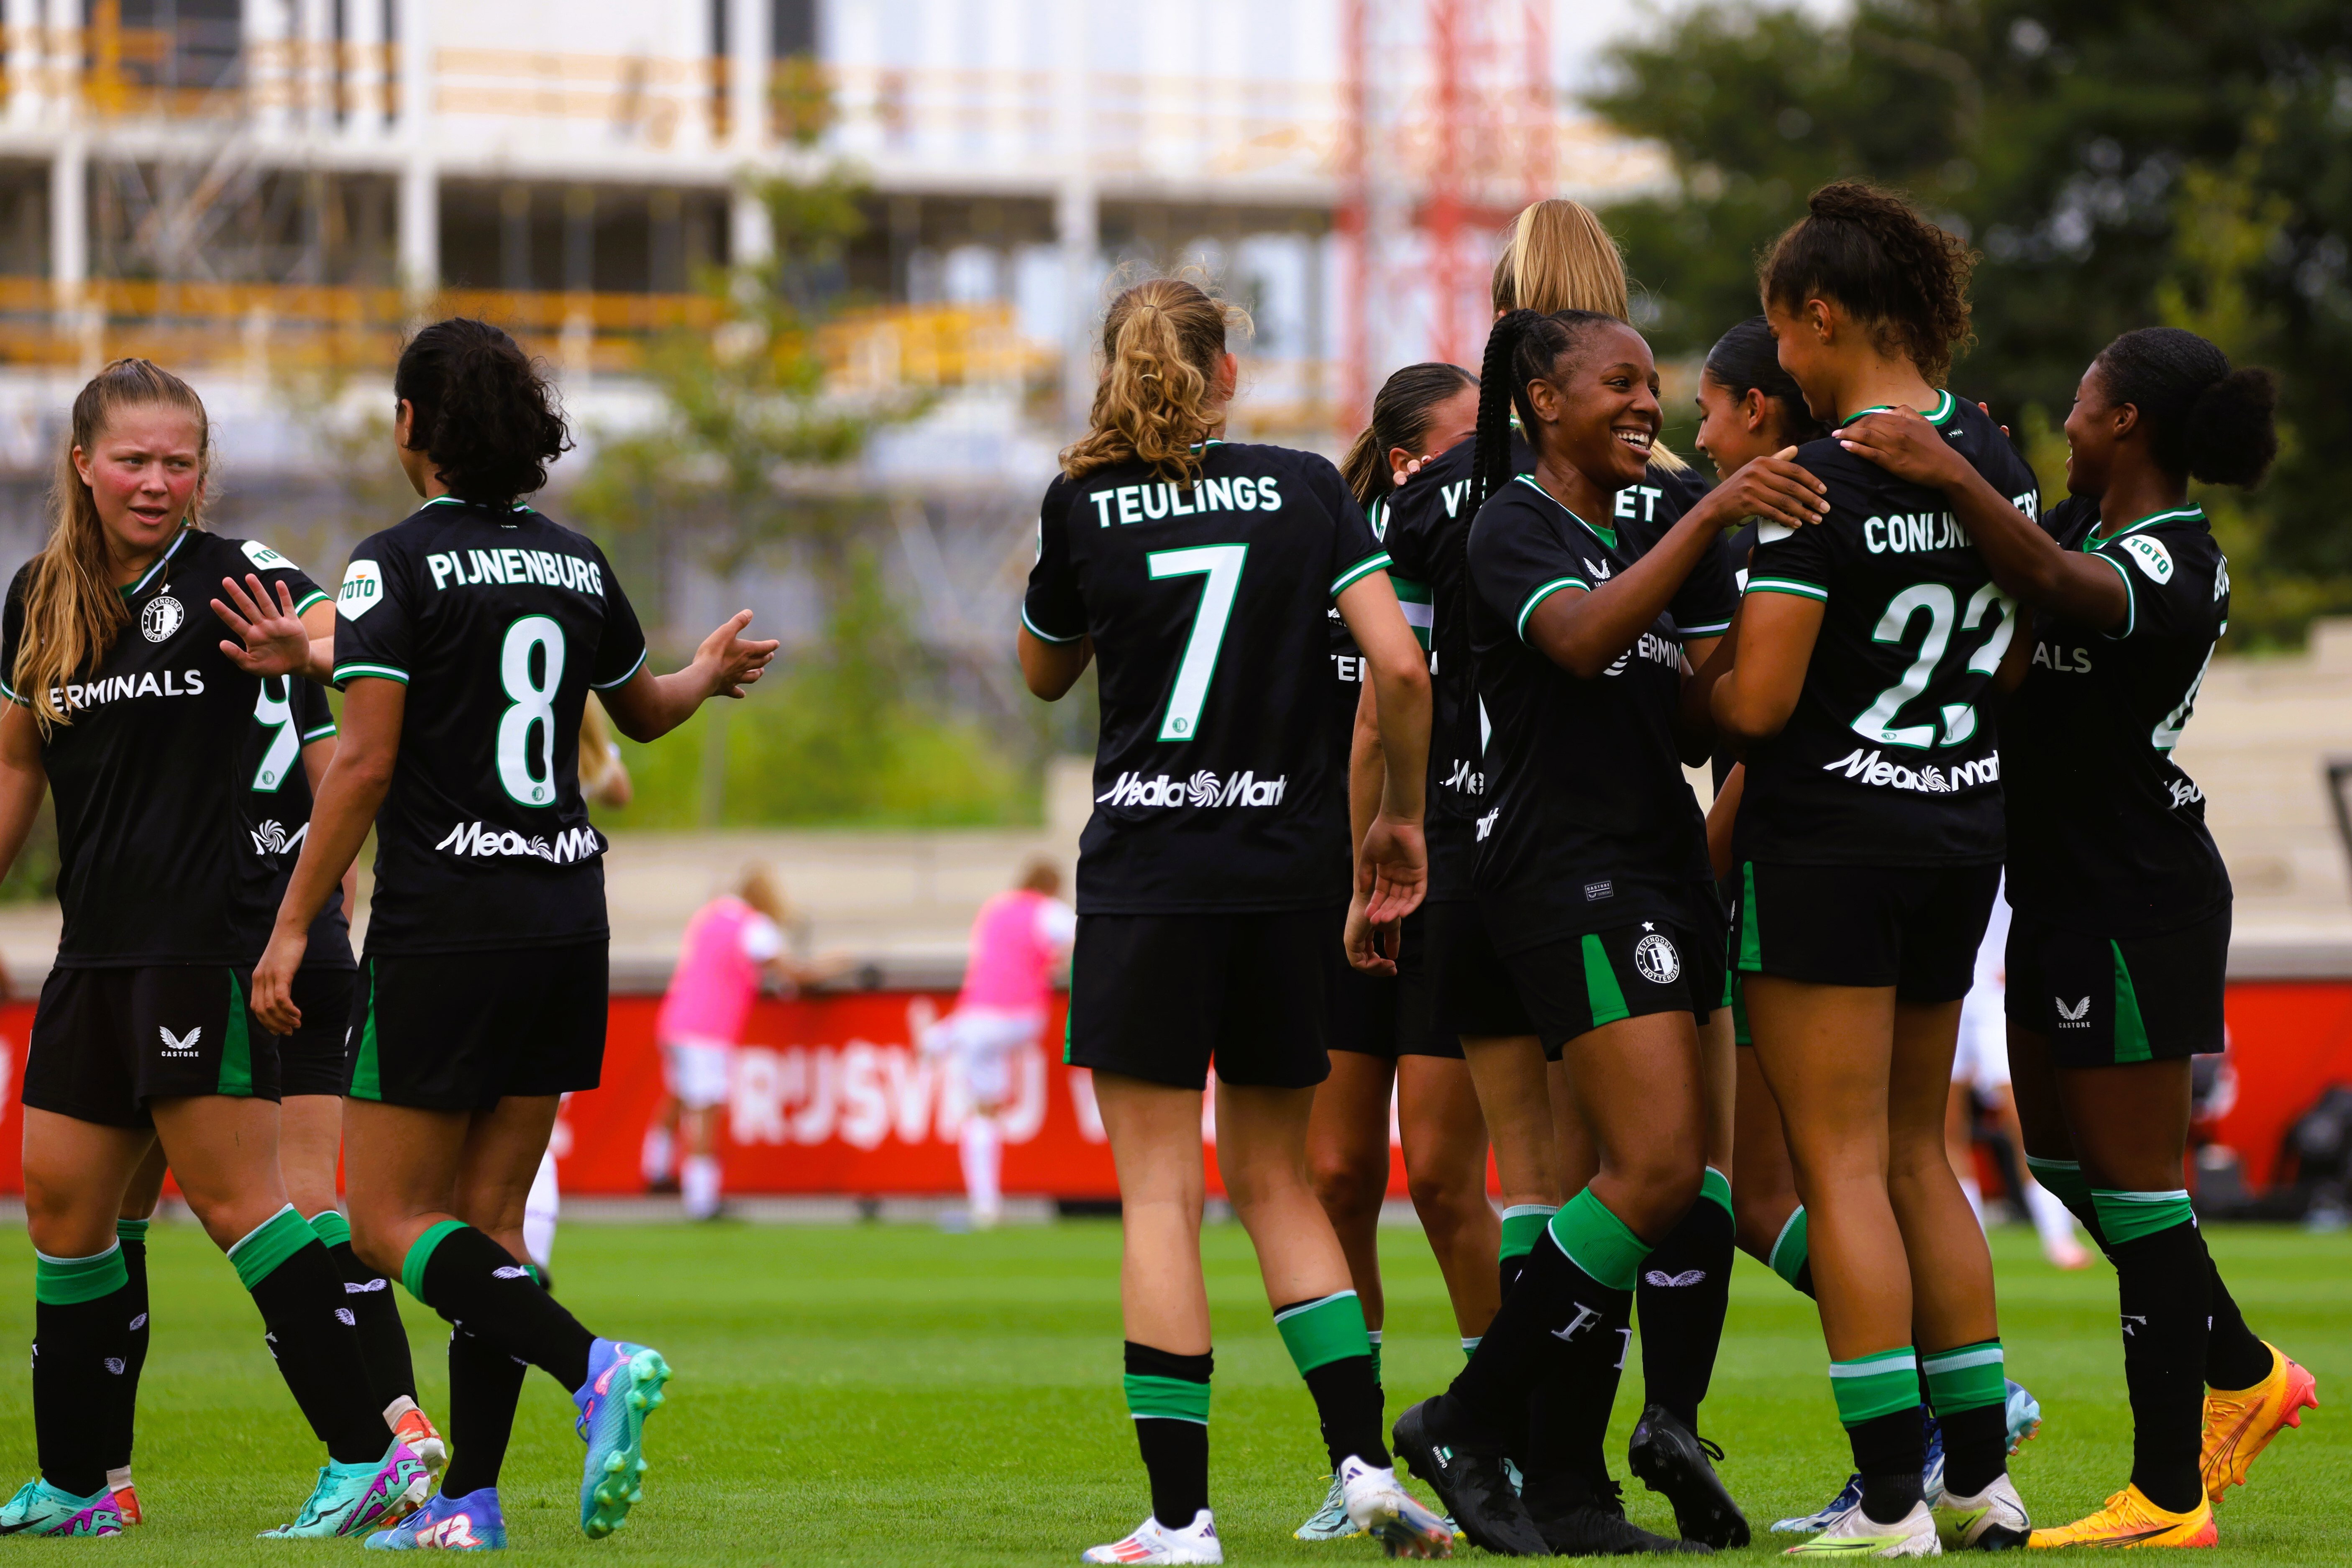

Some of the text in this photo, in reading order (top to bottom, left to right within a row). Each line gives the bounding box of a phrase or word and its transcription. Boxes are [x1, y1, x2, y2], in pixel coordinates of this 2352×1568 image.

[1090, 476, 1282, 528] TEULINGS
[2131, 538, 2169, 575] TOTO
[426, 548, 604, 597] PIJNENBURG
[341, 579, 376, 601] TOTO
[145, 598, 182, 616] FEYENOORD
[144, 623, 179, 641] ROTTERDAM
[1146, 543, 1250, 742] 7
[49, 669, 205, 713] ERMINALS
[495, 614, 566, 808] 8
[1638, 936, 1673, 956] FEYENOORD
[1643, 964, 1678, 982] ROTTERDAM
[1433, 1446, 1448, 1468] OBISPO
